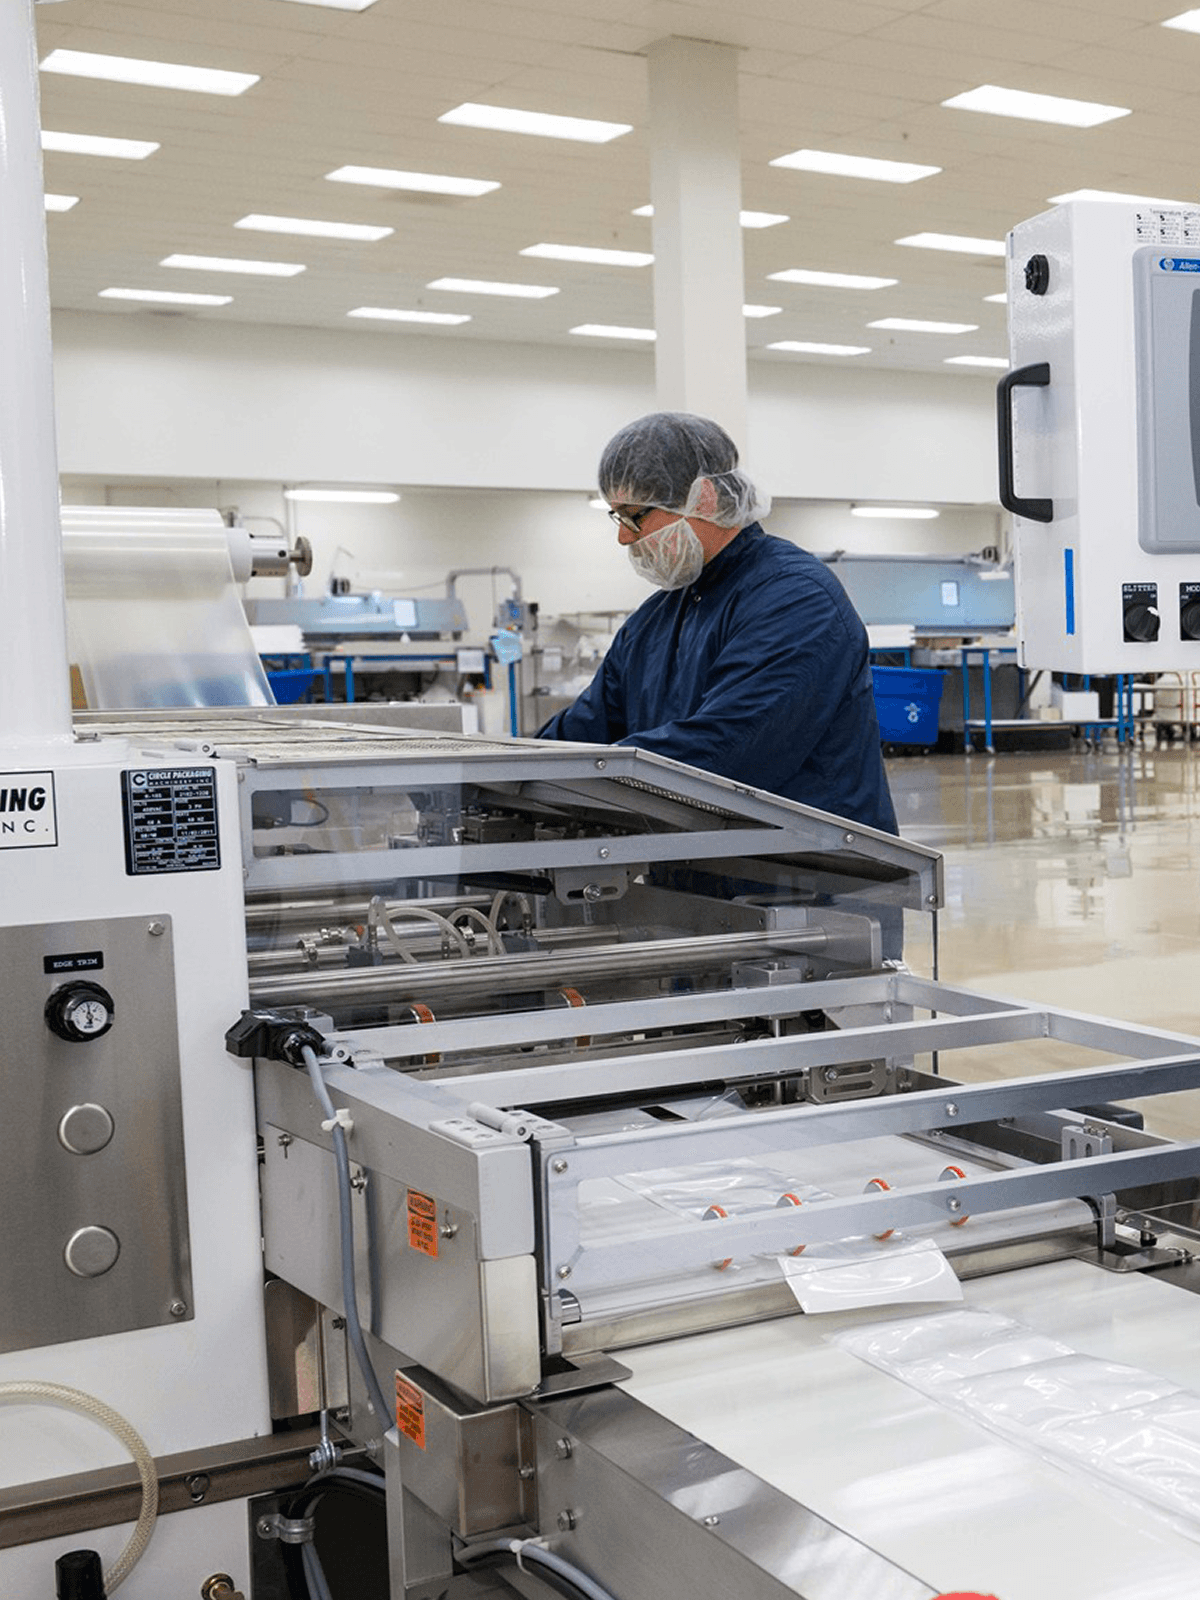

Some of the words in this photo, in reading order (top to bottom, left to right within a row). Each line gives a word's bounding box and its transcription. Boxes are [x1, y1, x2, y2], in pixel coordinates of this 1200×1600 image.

[1123, 584, 1157, 592] SLITTER
[148, 772, 171, 780] CIRCLE
[172, 770, 212, 779] PACKAGING
[0, 787, 46, 812] ING
[53, 960, 73, 969] EDGE
[77, 957, 98, 966] TRIM
